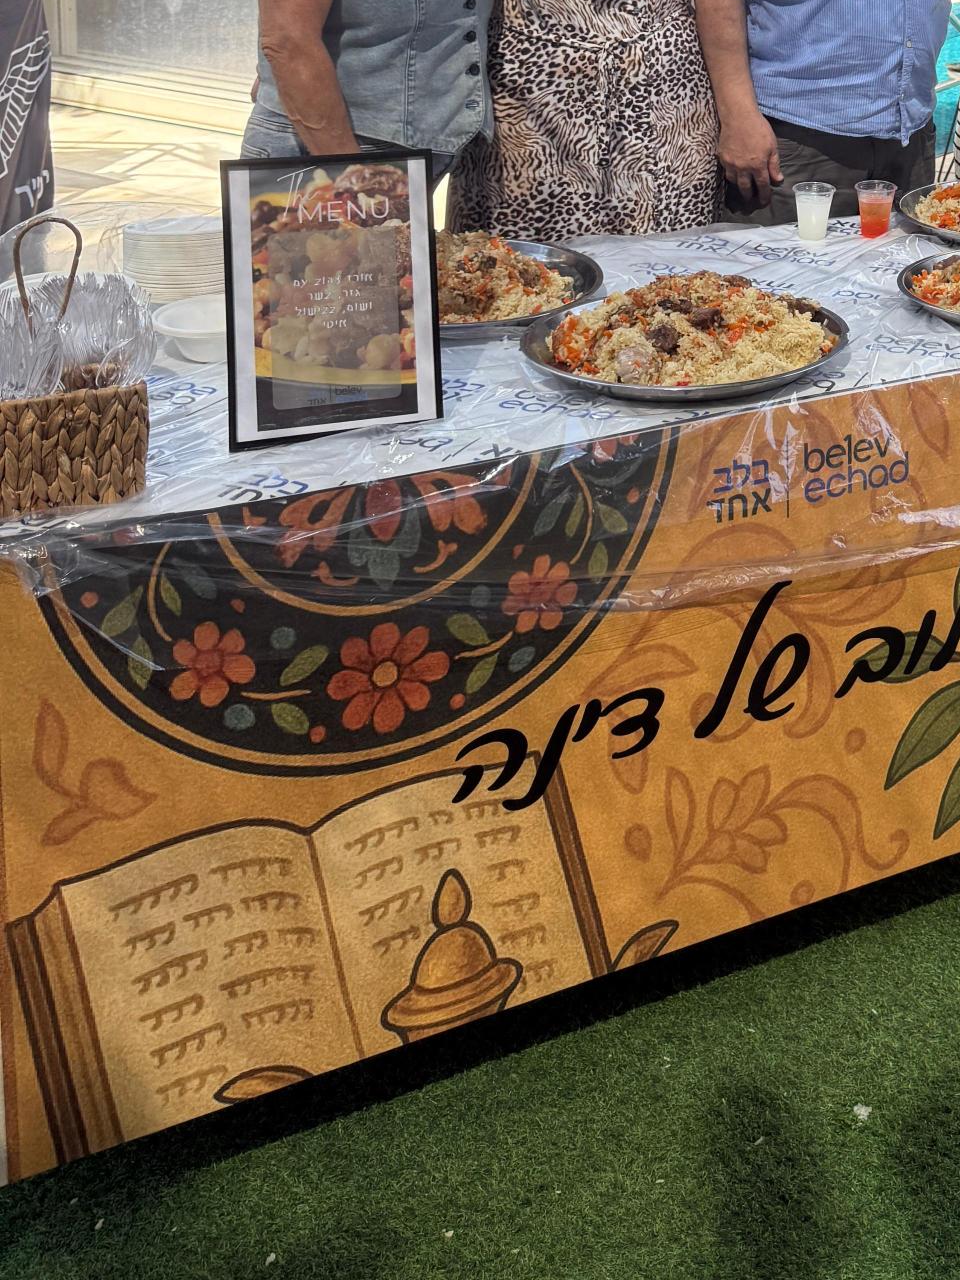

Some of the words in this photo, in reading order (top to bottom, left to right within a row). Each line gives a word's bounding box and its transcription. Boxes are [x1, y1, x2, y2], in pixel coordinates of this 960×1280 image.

[298, 197, 389, 224] MENU
[293, 279, 307, 288] עם
[347, 272, 373, 282] אורז
[713, 459, 769, 494] בלב
[804, 451, 909, 504] echad
[706, 488, 772, 523] אחד
[694, 580, 811, 739] של
[451, 687, 666, 812] דינה
